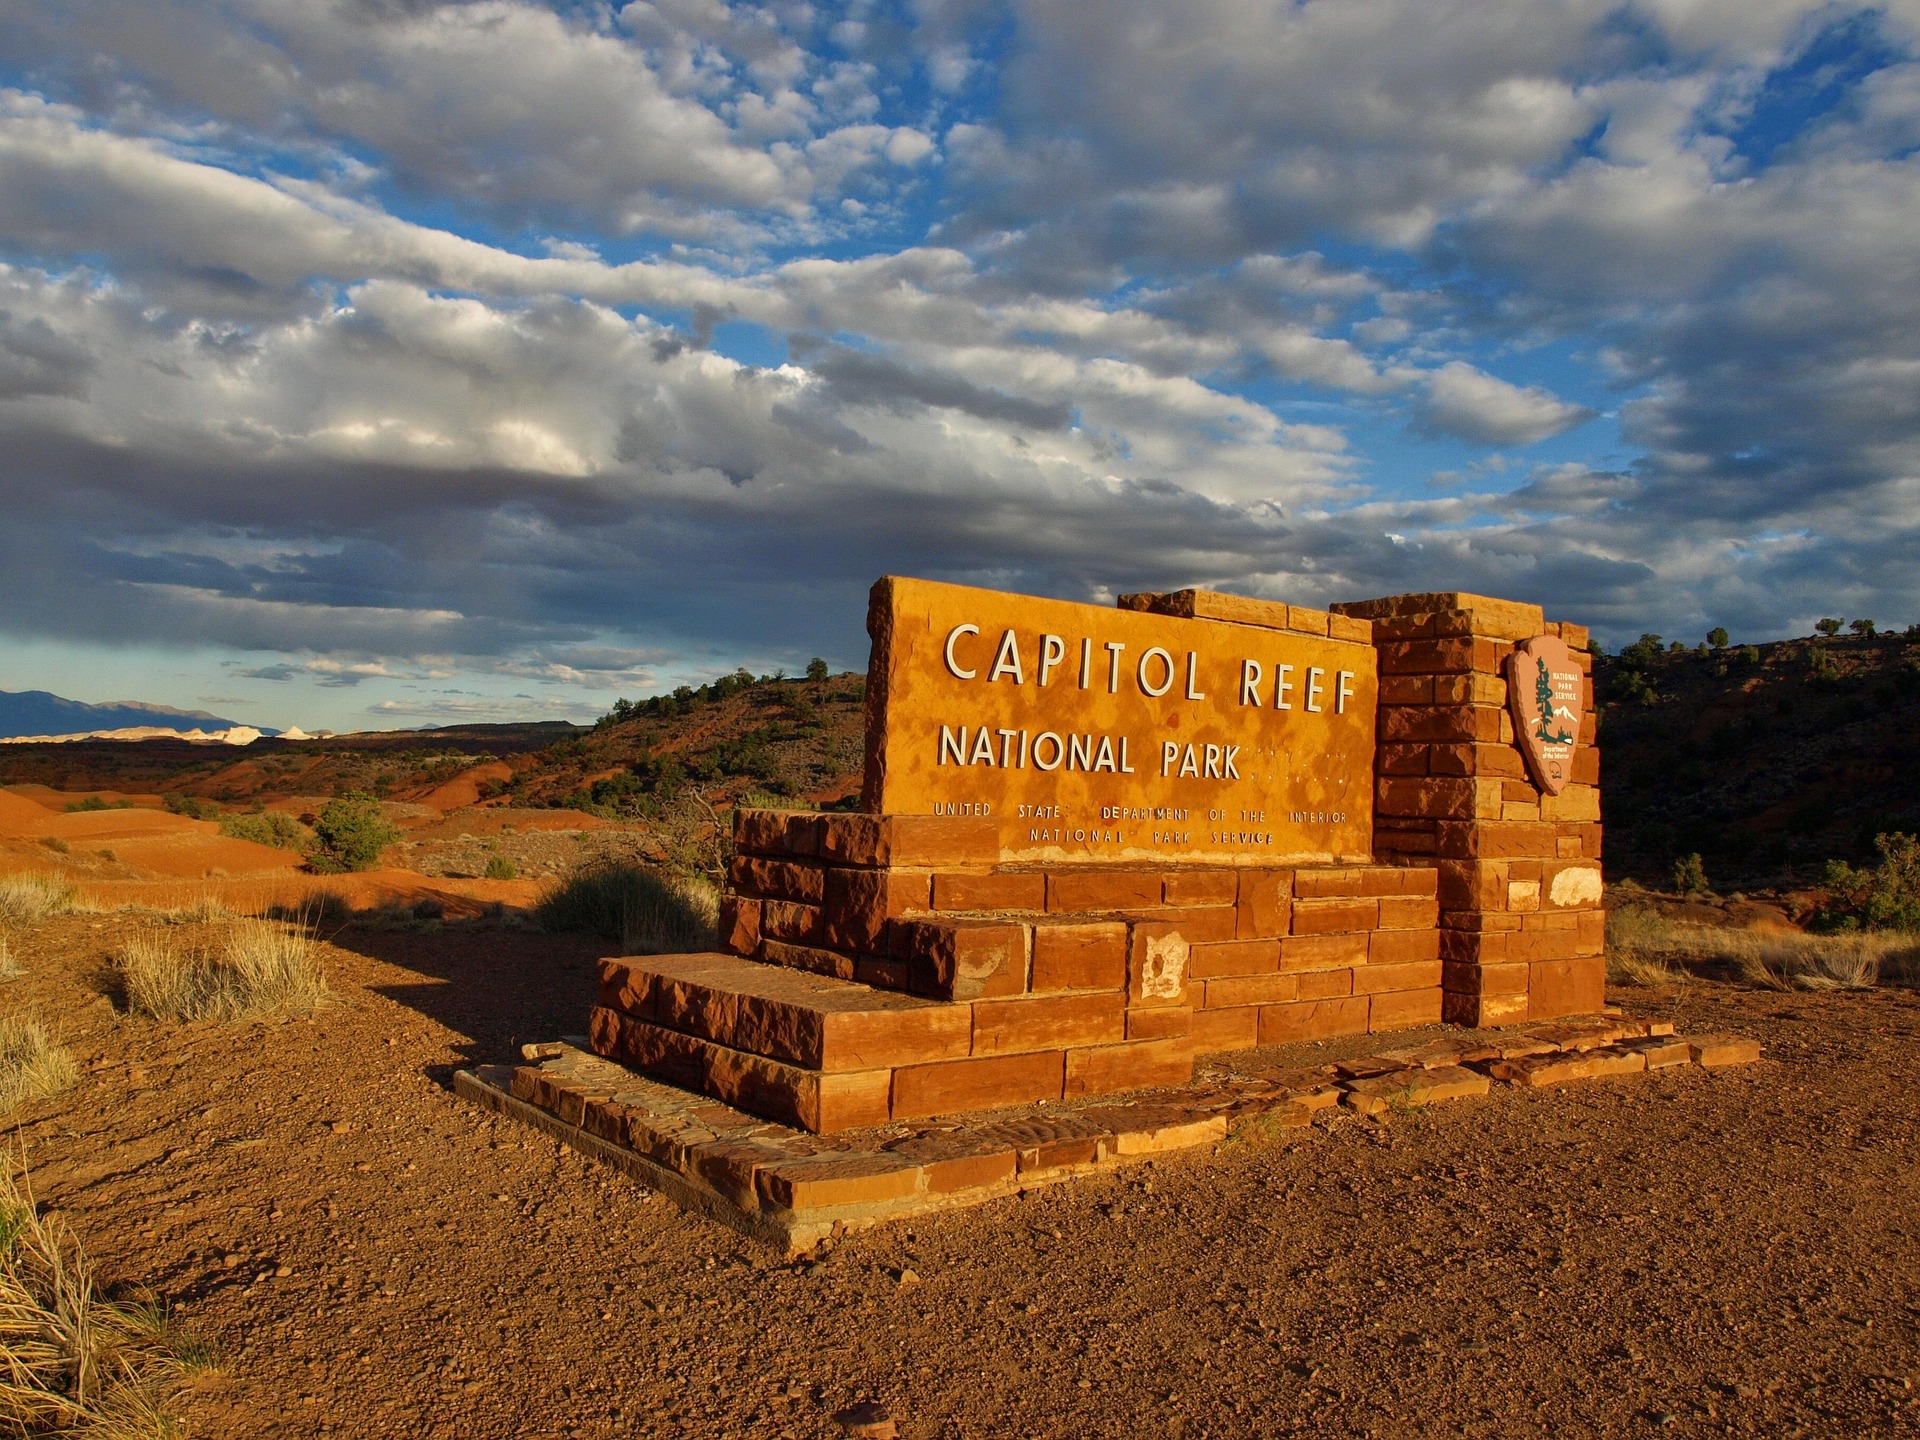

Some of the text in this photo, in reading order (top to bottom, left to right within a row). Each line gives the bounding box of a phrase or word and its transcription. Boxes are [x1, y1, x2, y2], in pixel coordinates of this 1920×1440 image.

[944, 623, 1355, 714] CAPITOL REEF
[1552, 672, 1578, 681] NATIONAL
[1558, 682, 1572, 690] PARK
[1555, 691, 1576, 700] SERVICE
[938, 724, 1241, 780] NATIONAL PARK
[934, 802, 991, 816] UNITED
[1102, 806, 1189, 821] DEPARTMENT
[1208, 809, 1226, 821] OF
[1240, 810, 1265, 823] THE
[1288, 811, 1346, 823] INTERIOR
[1029, 829, 1273, 845] NATIONAL PARK SERVICE
